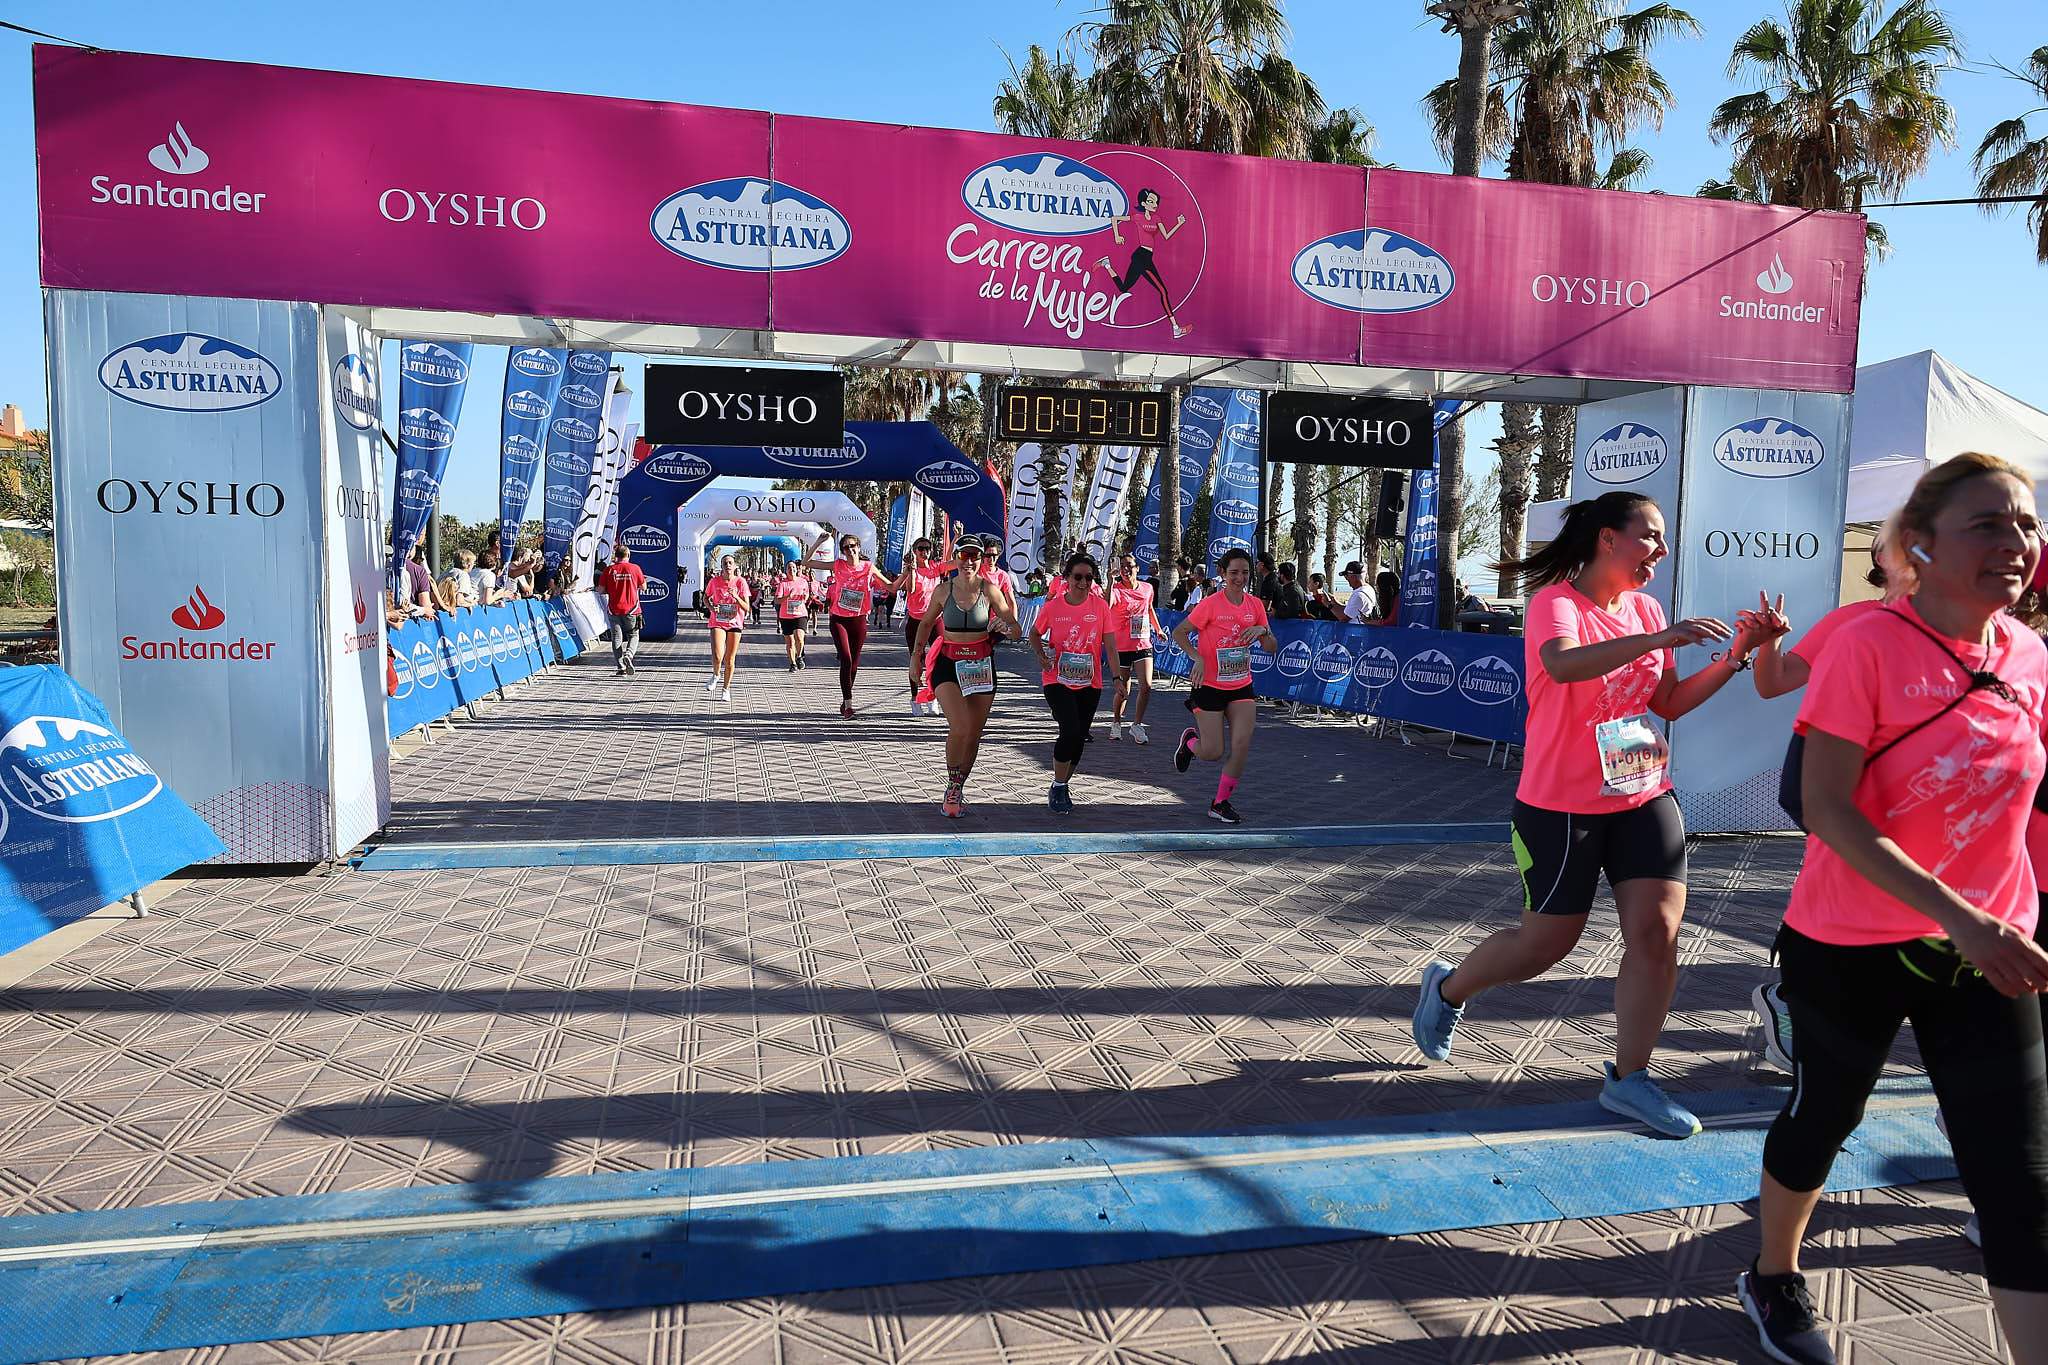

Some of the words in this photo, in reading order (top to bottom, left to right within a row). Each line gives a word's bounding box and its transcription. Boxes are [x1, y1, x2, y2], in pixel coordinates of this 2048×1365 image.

[91, 175, 266, 213] Santander
[1001, 177, 1054, 189] CENTRAL
[1059, 183, 1111, 194] LECHERA
[379, 188, 547, 231] OYSHO
[975, 178, 1114, 218] ASTURIANA
[698, 207, 761, 219] CENTRAL
[767, 211, 830, 223] LECHERA
[667, 207, 836, 250] ASTURIANA
[946, 223, 1083, 274] Carrera
[1304, 255, 1442, 294] ASTURIANA
[1330, 255, 1381, 266] CENTRAL
[1386, 259, 1438, 270] LECHERA
[1531, 275, 1651, 309] OYSHO
[979, 270, 1004, 299] de
[1010, 271, 1029, 301] la
[1024, 271, 1132, 340] Mujer
[1719, 295, 1826, 324] Santander
[113, 359, 269, 394] ASTURIANA
[141, 358, 199, 369] CENTRAL
[205, 362, 262, 372] LECHERA
[561, 389, 597, 406] ASTURIANA
[678, 390, 817, 425] OYSHO
[1187, 400, 1221, 418] ASTURIANA
[1009, 395, 1158, 437] 00:43:10
[554, 422, 593, 440] ASTURIANA
[1180, 432, 1210, 447] STURIANA
[1295, 415, 1411, 446] OYSHO
[1721, 438, 1815, 464] ASTURIANA
[1777, 439, 1813, 447] LECHERA
[649, 462, 706, 476] ASTURIANA
[1589, 449, 1661, 472] ASTURIANA
[921, 472, 976, 484] ASTURIANA
[97, 478, 285, 517] OYSHO
[337, 484, 379, 522] OYSHO
[734, 495, 816, 514] OYSHO
[1009, 463, 1040, 575] OYSHO
[1218, 508, 1257, 520] ASTURIANA
[622, 536, 667, 547] ASTURIANA
[1705, 530, 1819, 559] OYSHO
[122, 635, 276, 660] Santander
[344, 632, 378, 654] Santander
[1314, 660, 1349, 674] ASTURIANA
[1357, 661, 1394, 679] ASTURIANA
[1404, 665, 1450, 685] ASTURIANA
[1462, 670, 1513, 695] ASTURIANA
[27, 749, 79, 768] CENTRAL
